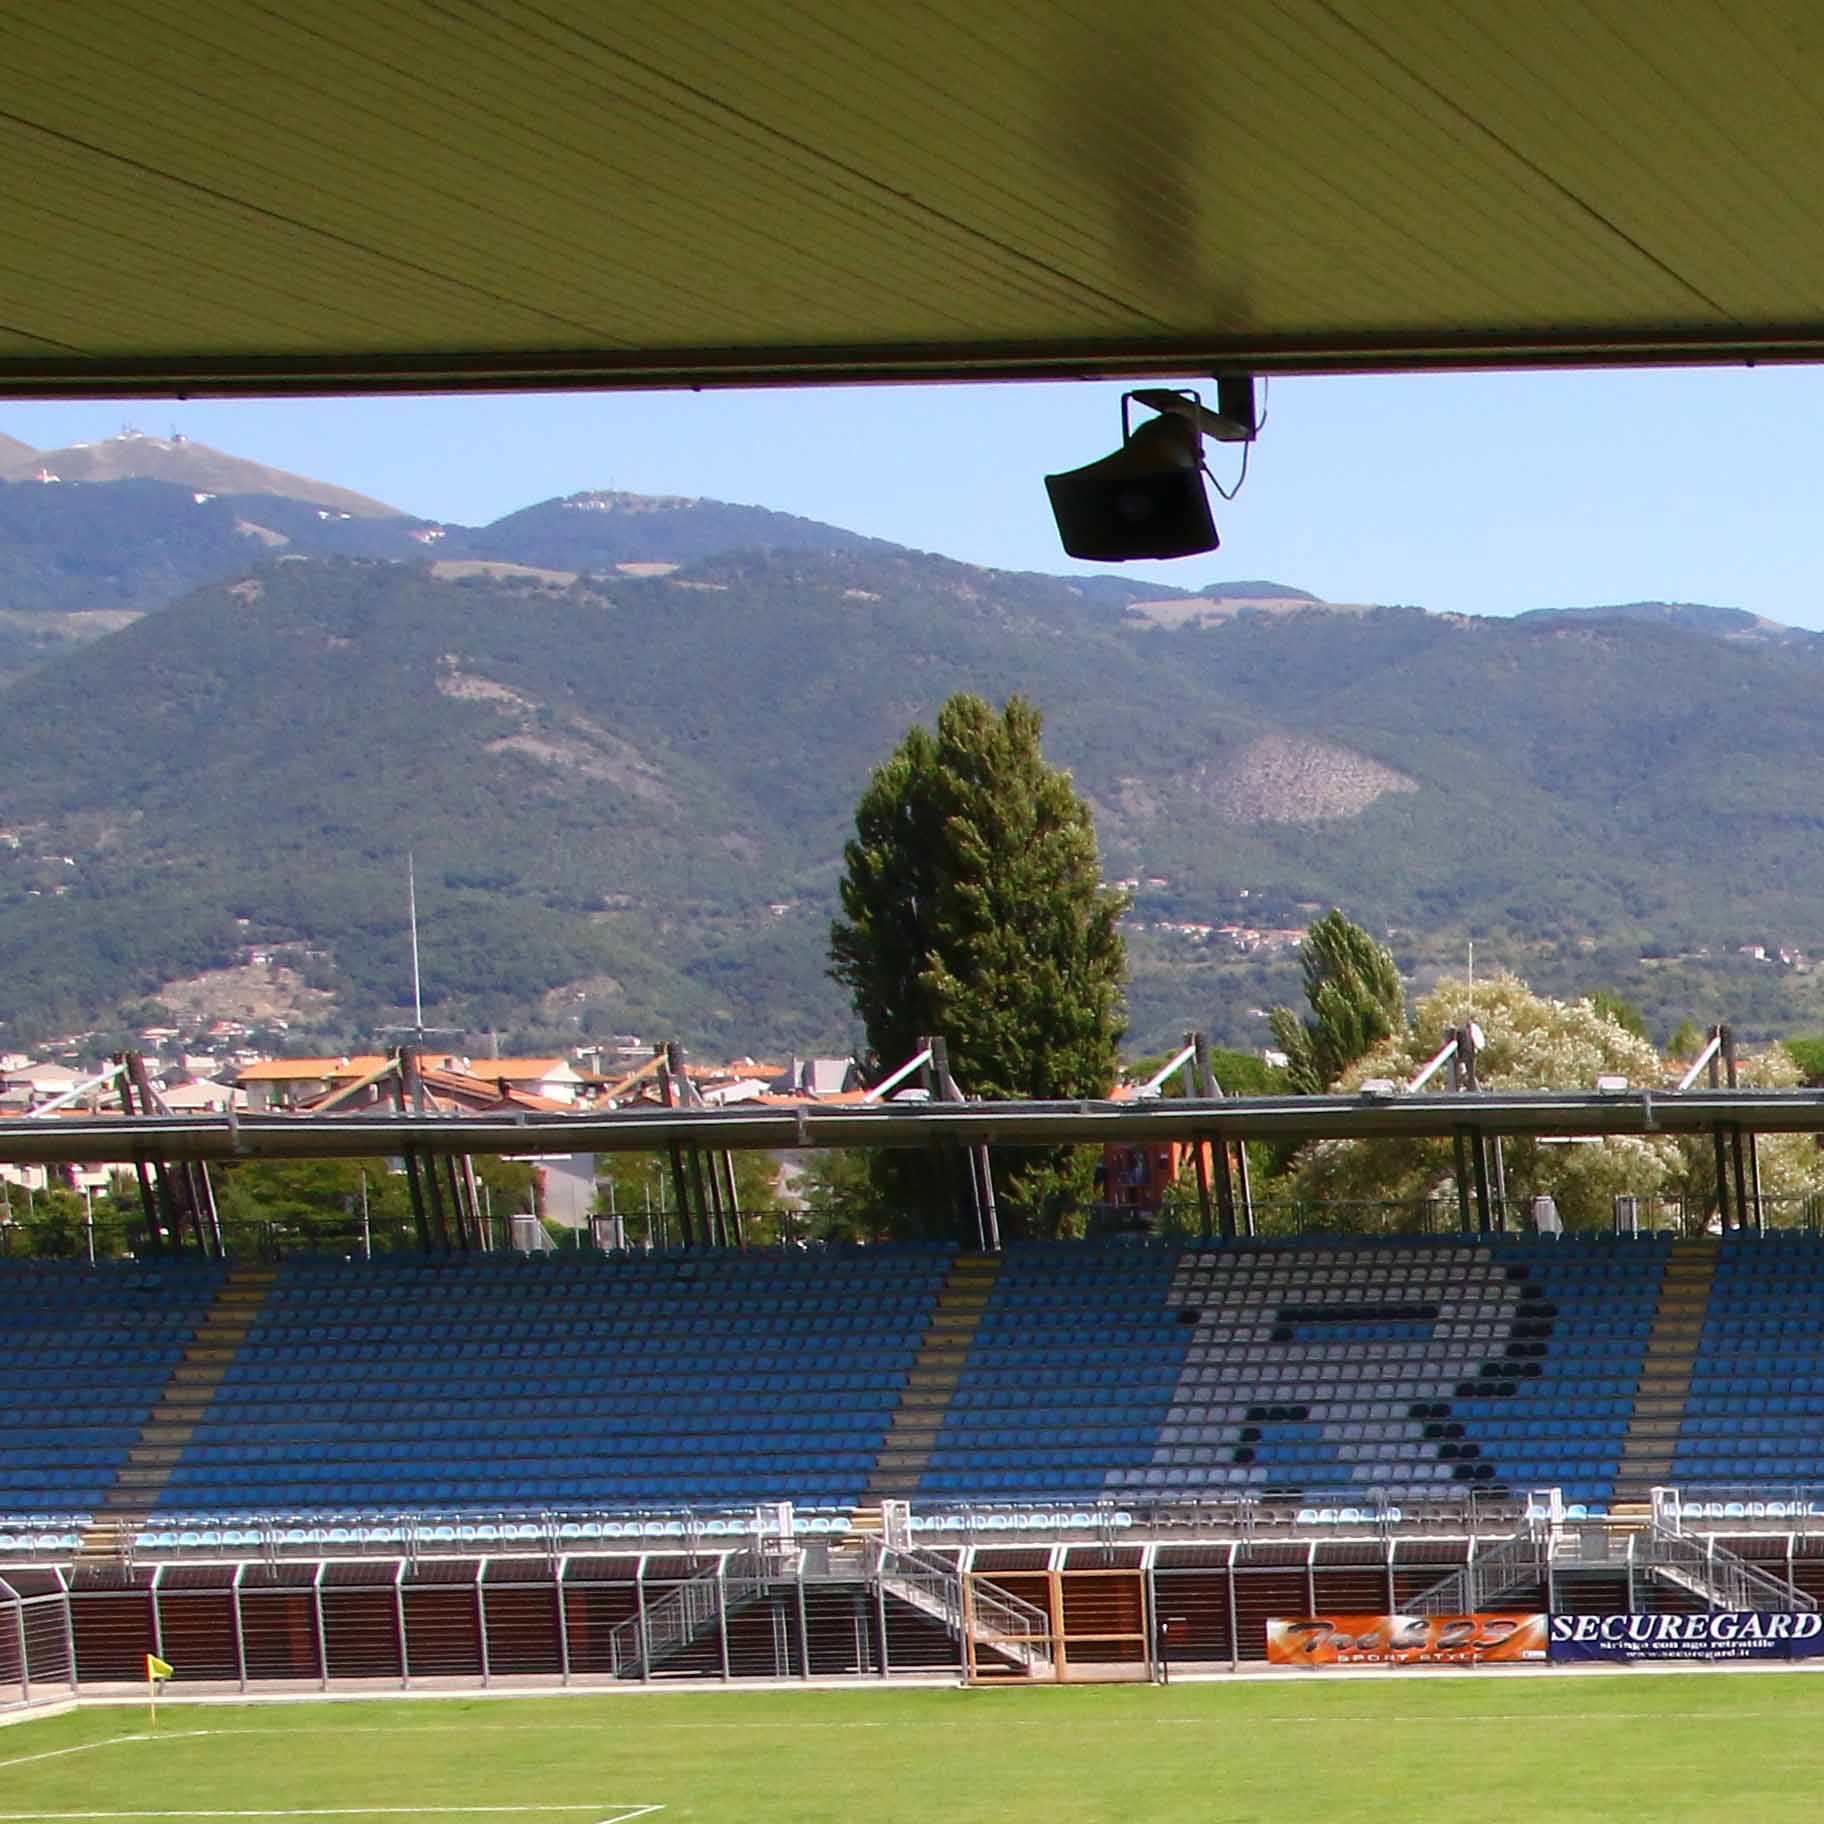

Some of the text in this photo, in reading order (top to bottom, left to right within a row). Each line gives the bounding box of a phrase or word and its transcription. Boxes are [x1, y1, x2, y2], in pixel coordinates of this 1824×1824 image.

[1551, 1613, 1823, 1641] SECUREGARD
[1652, 1641, 1679, 1649] con
[1681, 1641, 1708, 1650] ago
[1710, 1638, 1775, 1649] retrattile
[1336, 1651, 1485, 1663] SPORT STYLE
